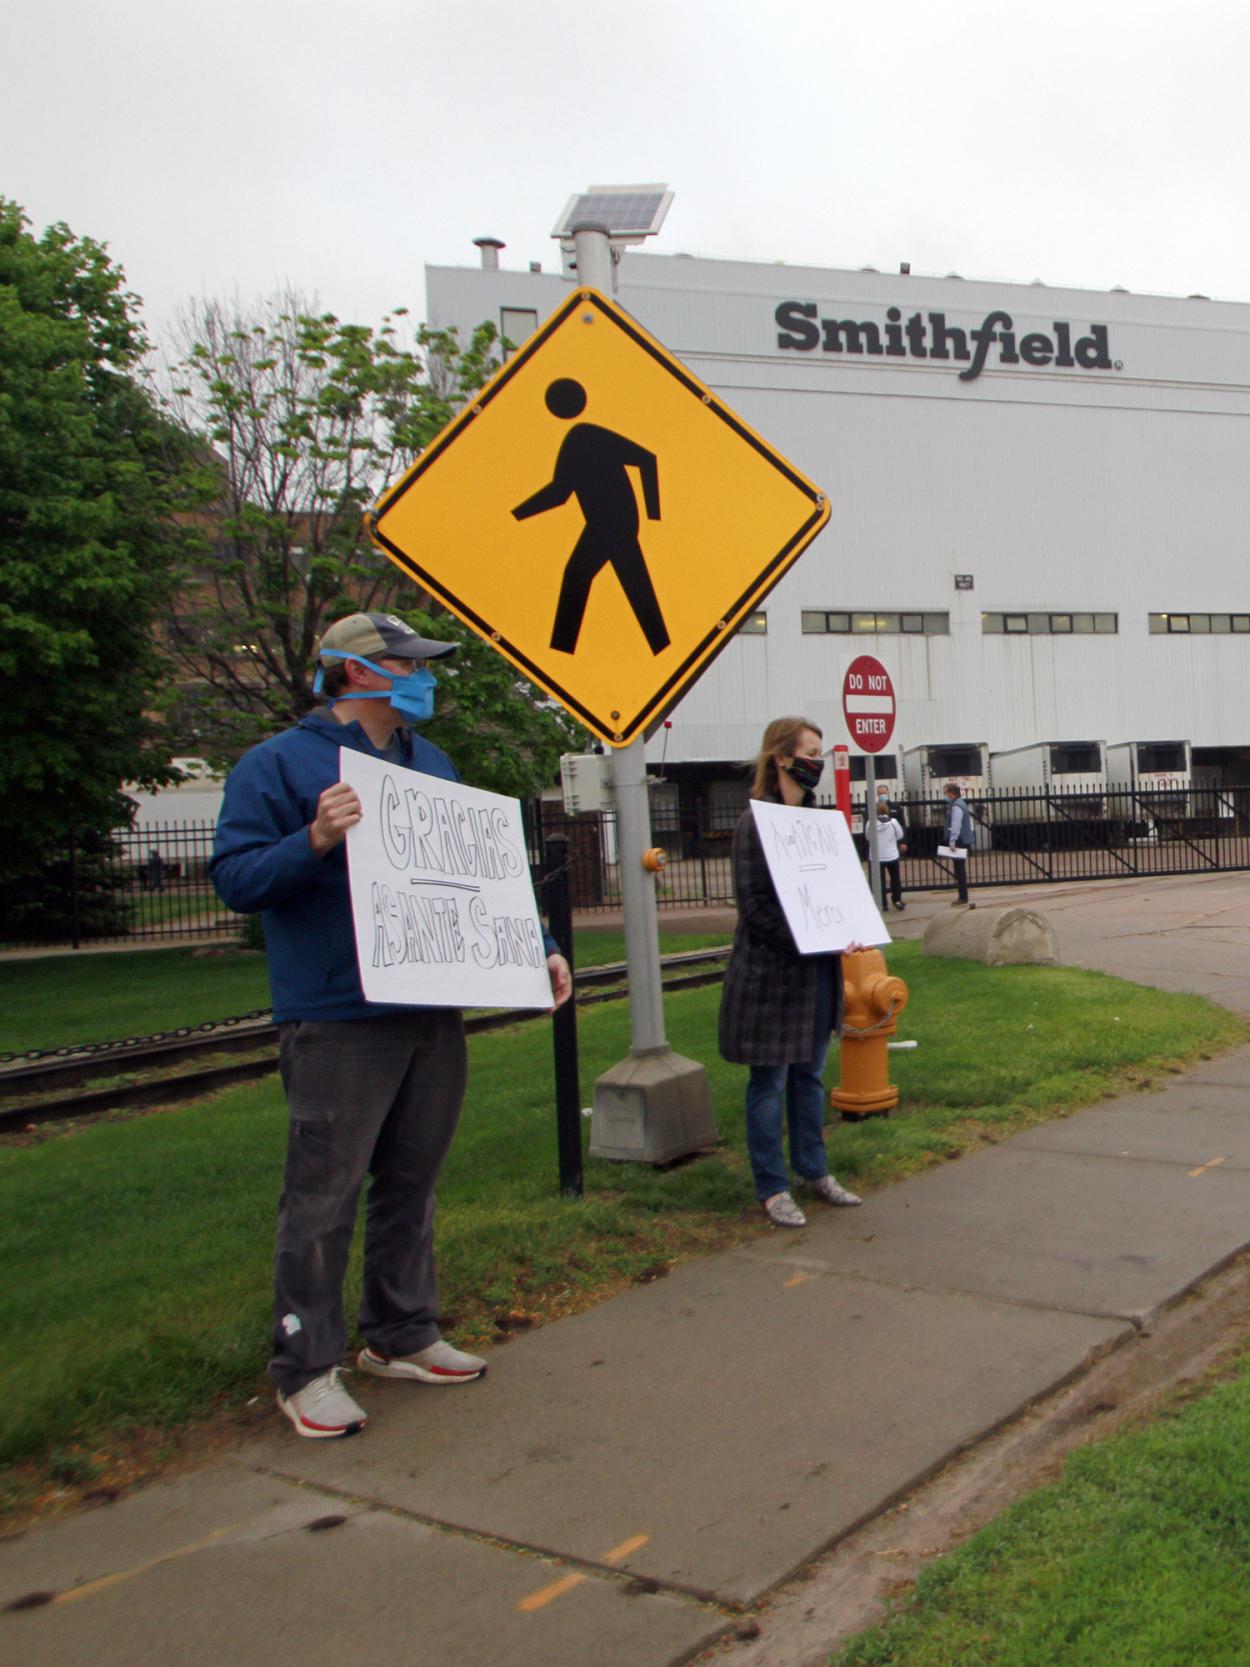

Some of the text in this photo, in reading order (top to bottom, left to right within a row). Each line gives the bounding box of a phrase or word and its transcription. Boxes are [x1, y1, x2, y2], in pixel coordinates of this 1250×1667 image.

[775, 301, 1112, 381] Smithfield
[849, 674, 887, 691] DO NOT
[855, 719, 886, 734] ENTER
[380, 774, 524, 880] GRACIAS
[371, 881, 465, 968] ASANTE
